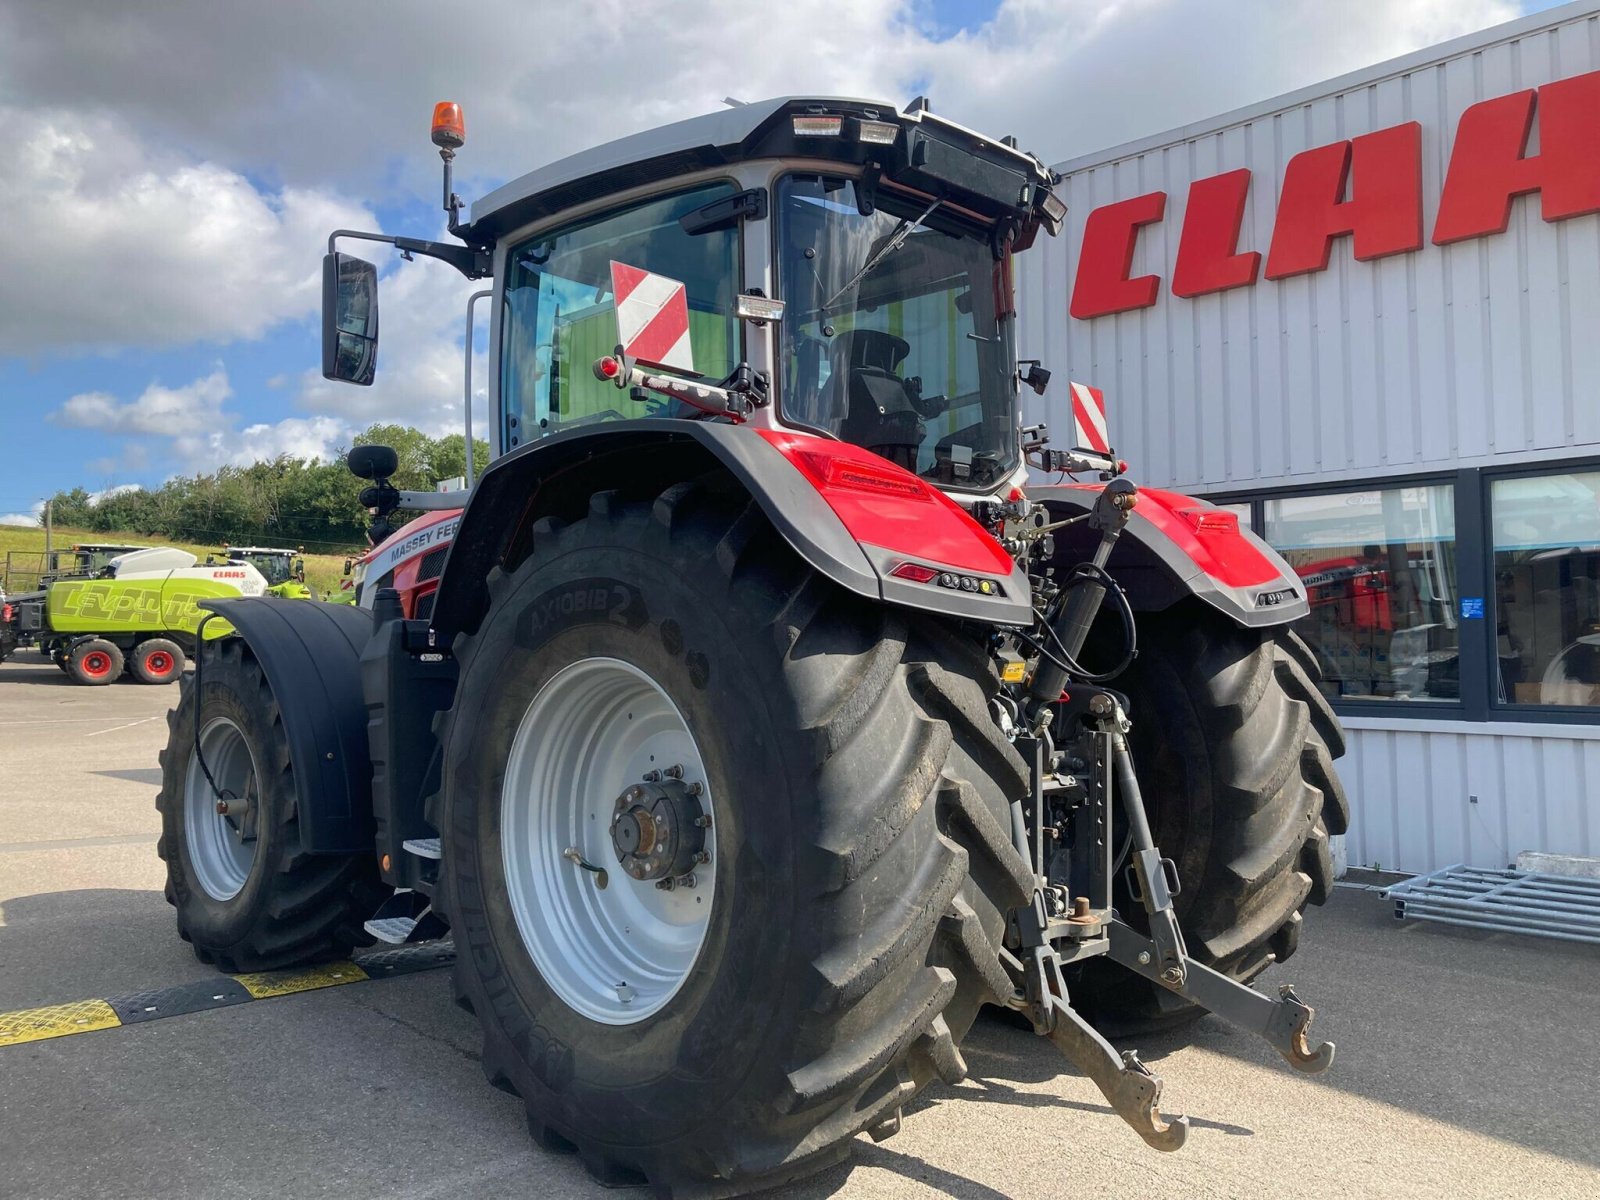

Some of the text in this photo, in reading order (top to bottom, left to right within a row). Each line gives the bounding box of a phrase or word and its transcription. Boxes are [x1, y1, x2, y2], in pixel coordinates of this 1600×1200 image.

[391, 530, 434, 563] MASSEY
[531, 585, 631, 636] AXIOBIB 2
